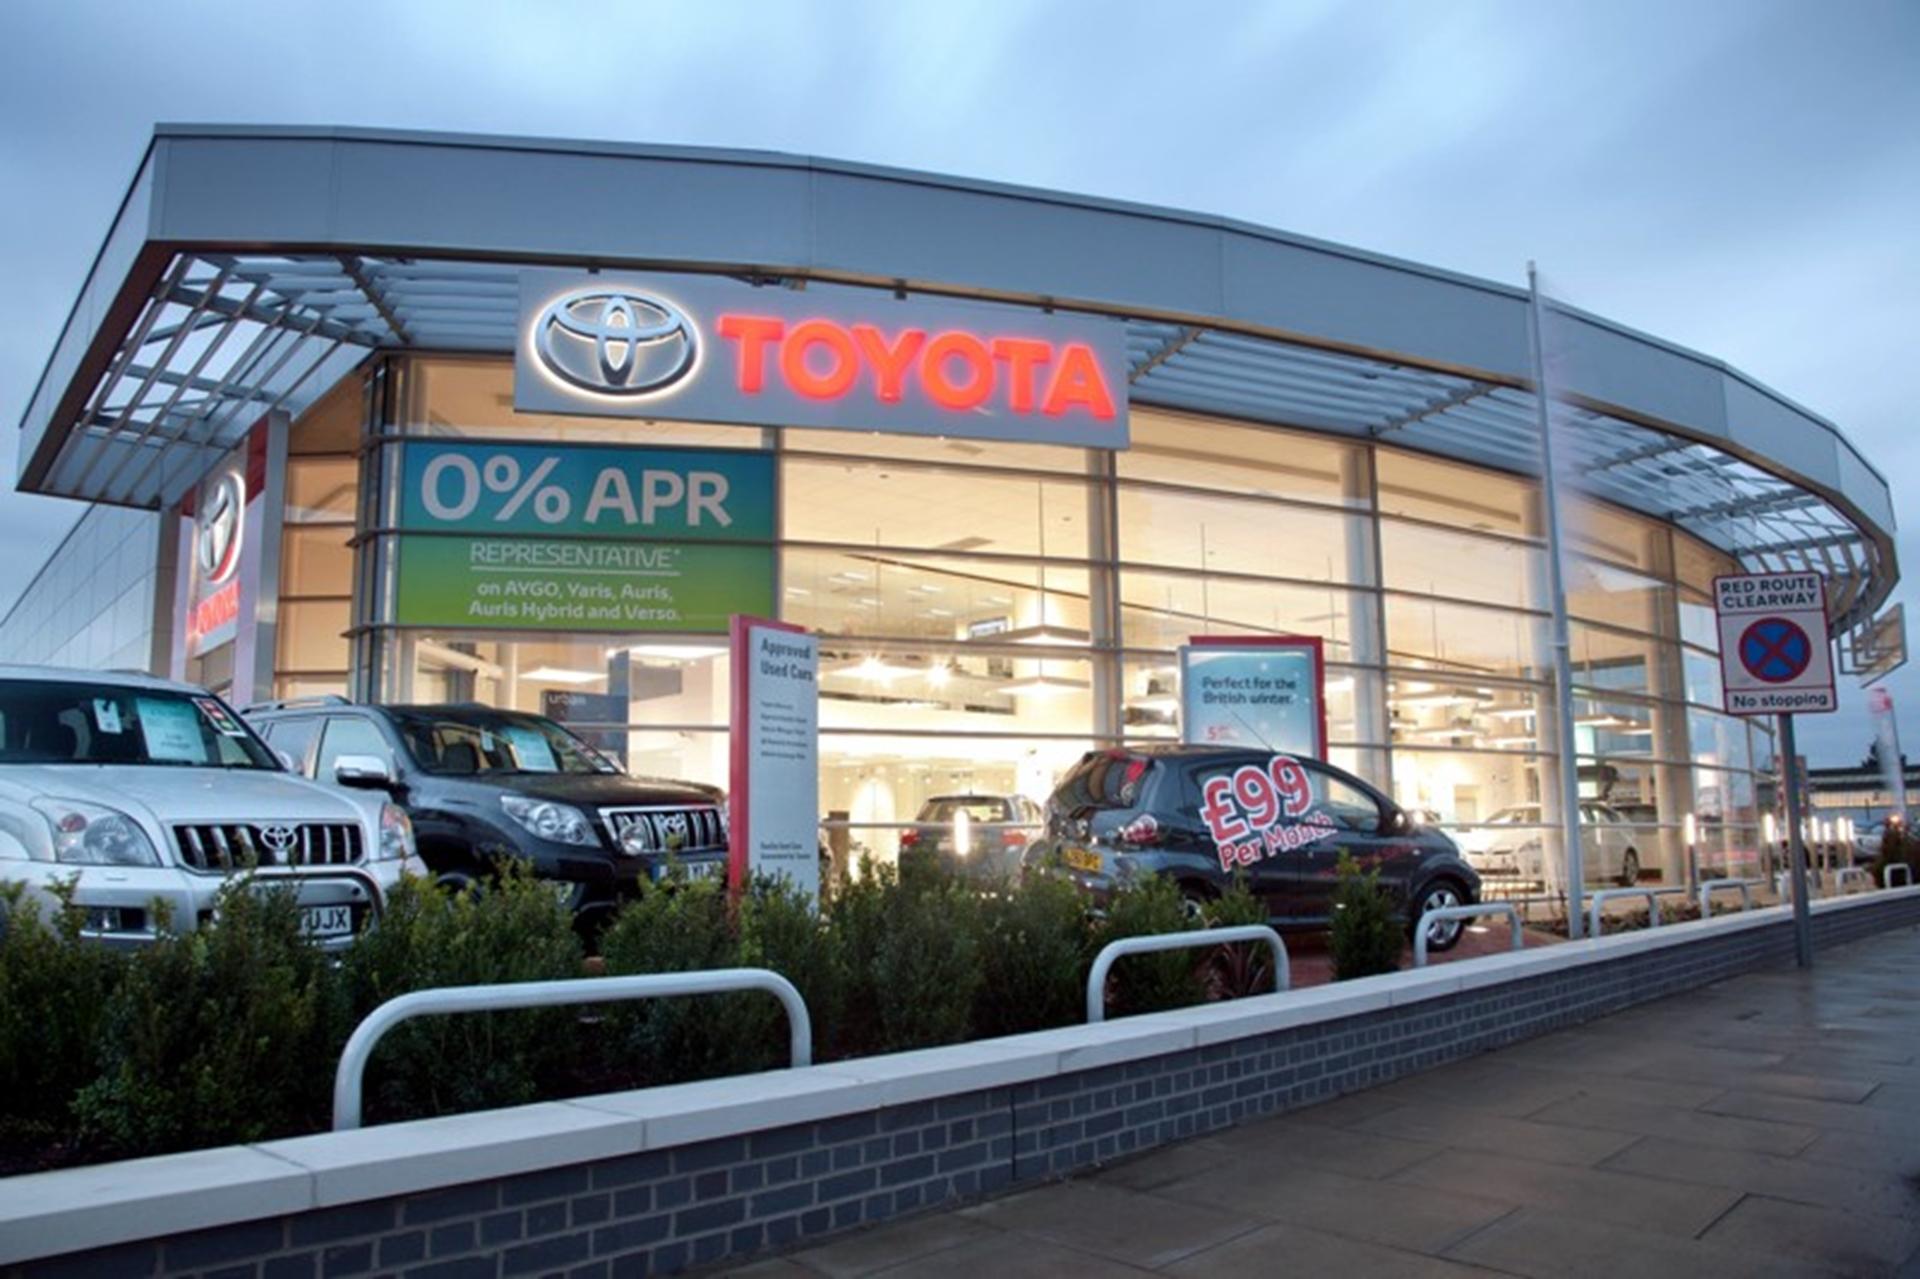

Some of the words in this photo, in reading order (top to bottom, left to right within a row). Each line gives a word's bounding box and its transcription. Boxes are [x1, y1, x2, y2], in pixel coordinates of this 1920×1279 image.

[718, 312, 1116, 421] TOYOTA
[421, 453, 571, 523] 0%
[583, 467, 733, 527] APR
[477, 581, 500, 597] on
[503, 580, 563, 599] AYGO,
[567, 582, 617, 602] Yaris,
[620, 583, 673, 603] Auris,
[1721, 582, 1755, 594] RED
[1761, 577, 1818, 591] ROUTE
[468, 600, 517, 618] Auris
[521, 602, 584, 622] Hybrid
[587, 604, 621, 620] and
[624, 604, 682, 621] Verso.
[1723, 592, 1816, 609] CLEARWAY
[761, 637, 811, 659] Approved
[761, 660, 788, 678] Used
[790, 664, 814, 682] Cars
[1202, 676, 1250, 689] Perfect
[1253, 677, 1271, 689] for
[1275, 678, 1297, 690] the
[1203, 689, 1247, 704] British
[1734, 694, 1757, 708] No
[1761, 692, 1828, 707] stopping
[1201, 755, 1313, 845] £99
[1217, 838, 1263, 873] Per
